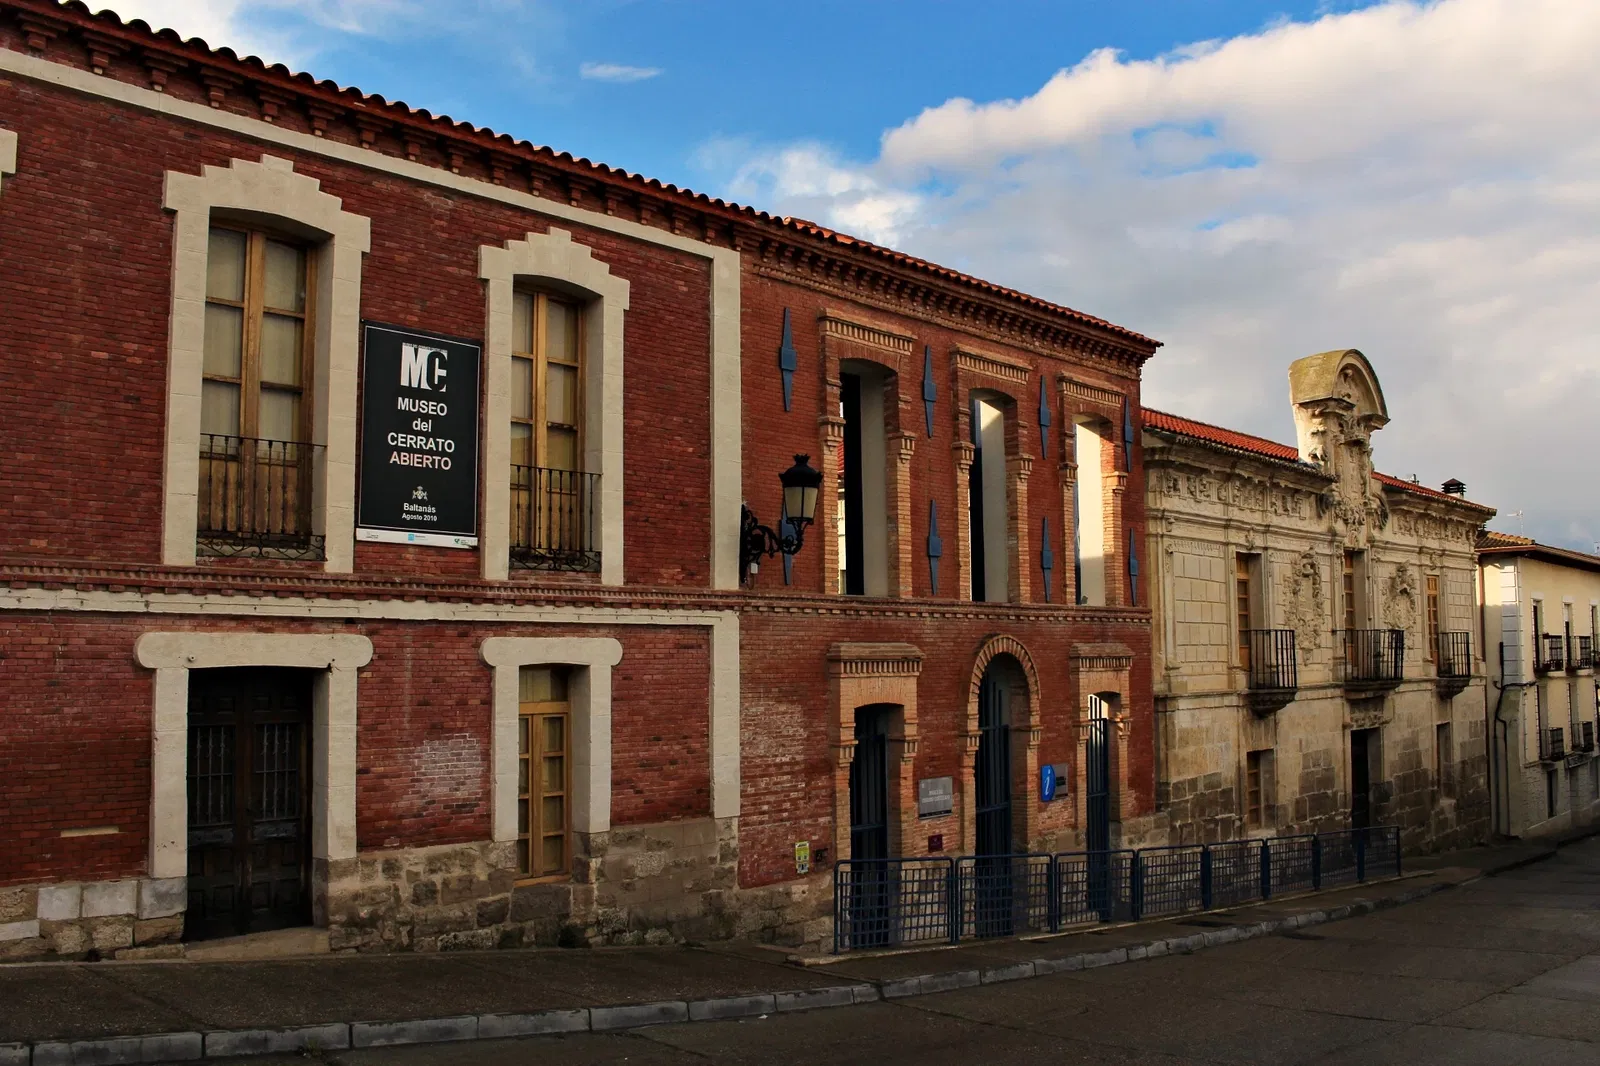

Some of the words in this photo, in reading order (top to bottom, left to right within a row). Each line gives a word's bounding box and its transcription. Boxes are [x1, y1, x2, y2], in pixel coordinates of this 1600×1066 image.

[397, 397, 448, 416] MUSEO
[412, 418, 432, 432] del
[387, 432, 455, 453] CERRATO
[389, 451, 452, 470] ABIERTO
[403, 502, 436, 514] Baltanás
[401, 512, 423, 521] Agosto
